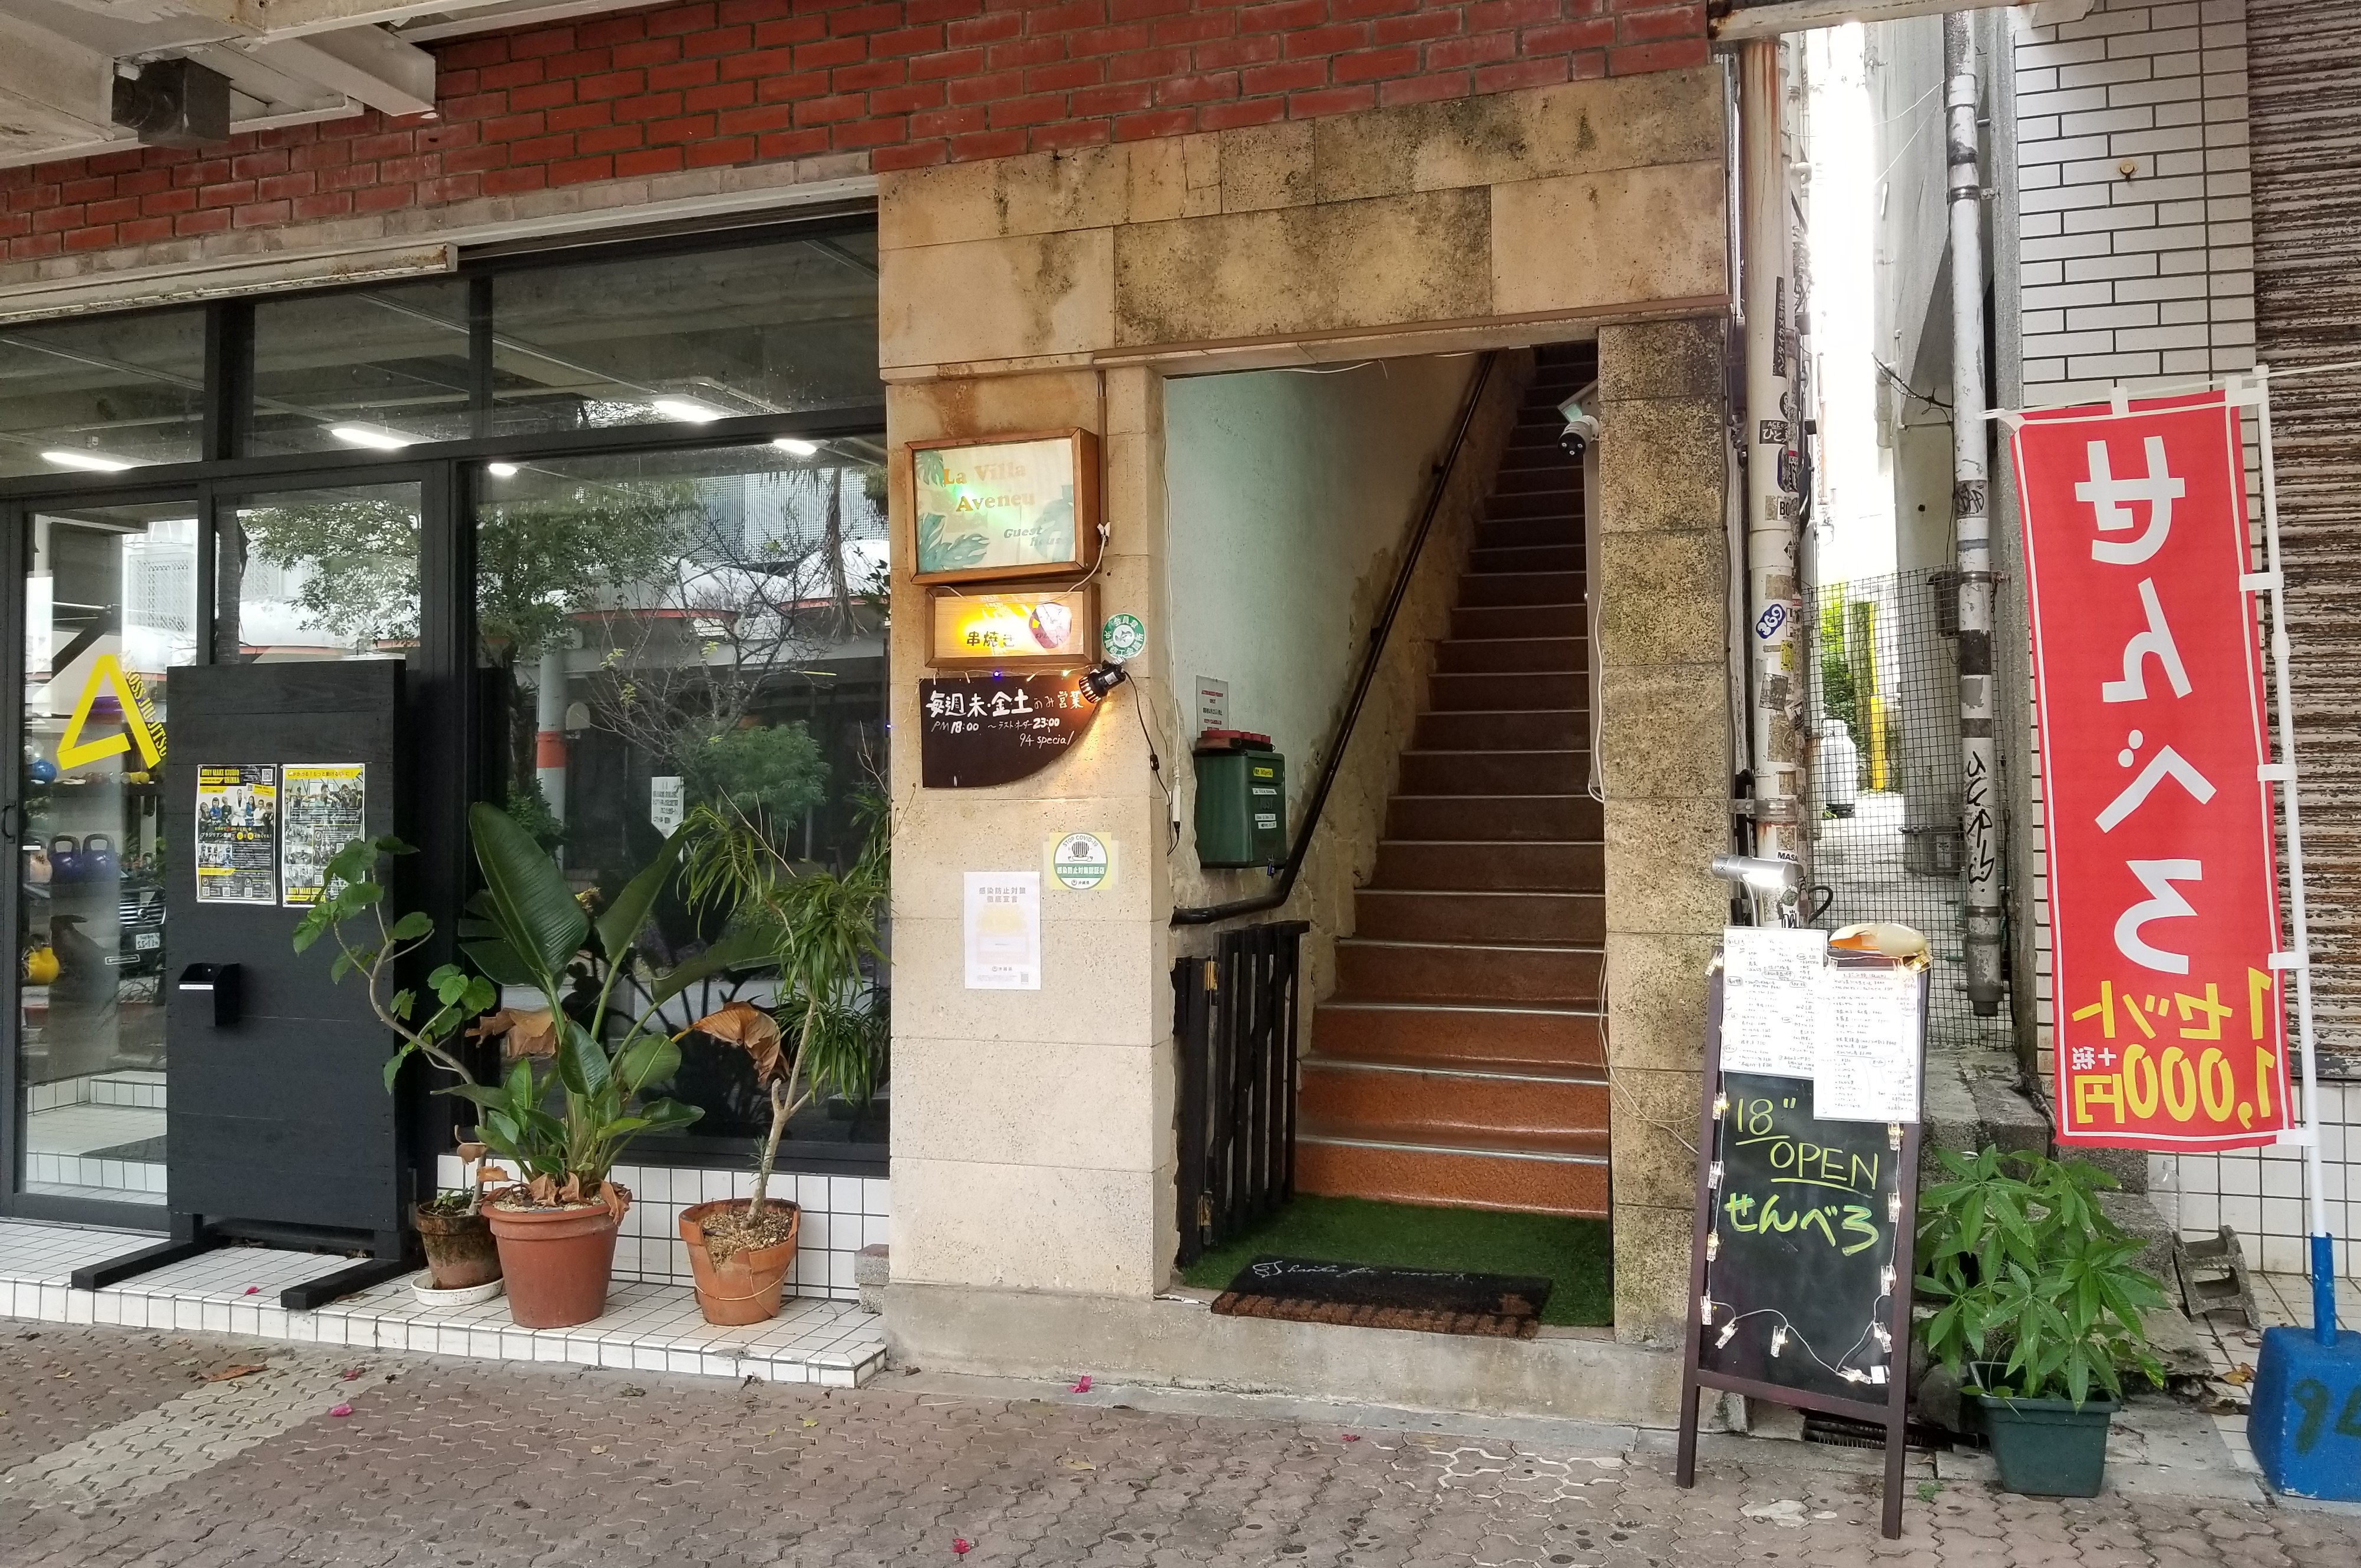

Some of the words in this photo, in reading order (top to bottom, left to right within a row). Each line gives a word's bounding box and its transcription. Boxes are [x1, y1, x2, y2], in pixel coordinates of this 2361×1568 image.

[943, 468, 967, 485] La
[974, 461, 1025, 481] Villa
[956, 491, 1035, 512] Aveneu
[1003, 526, 1042, 539] Guest
[1757, 605, 1784, 636] 369
[1019, 732, 1034, 747] 94
[1036, 730, 1075, 749] special
[1062, 836, 1075, 847] STOP
[1075, 835, 1098, 847] COVID-19
[1769, 1141, 1878, 1190] OPEN
[1724, 1193, 1880, 1256] せんべろ
